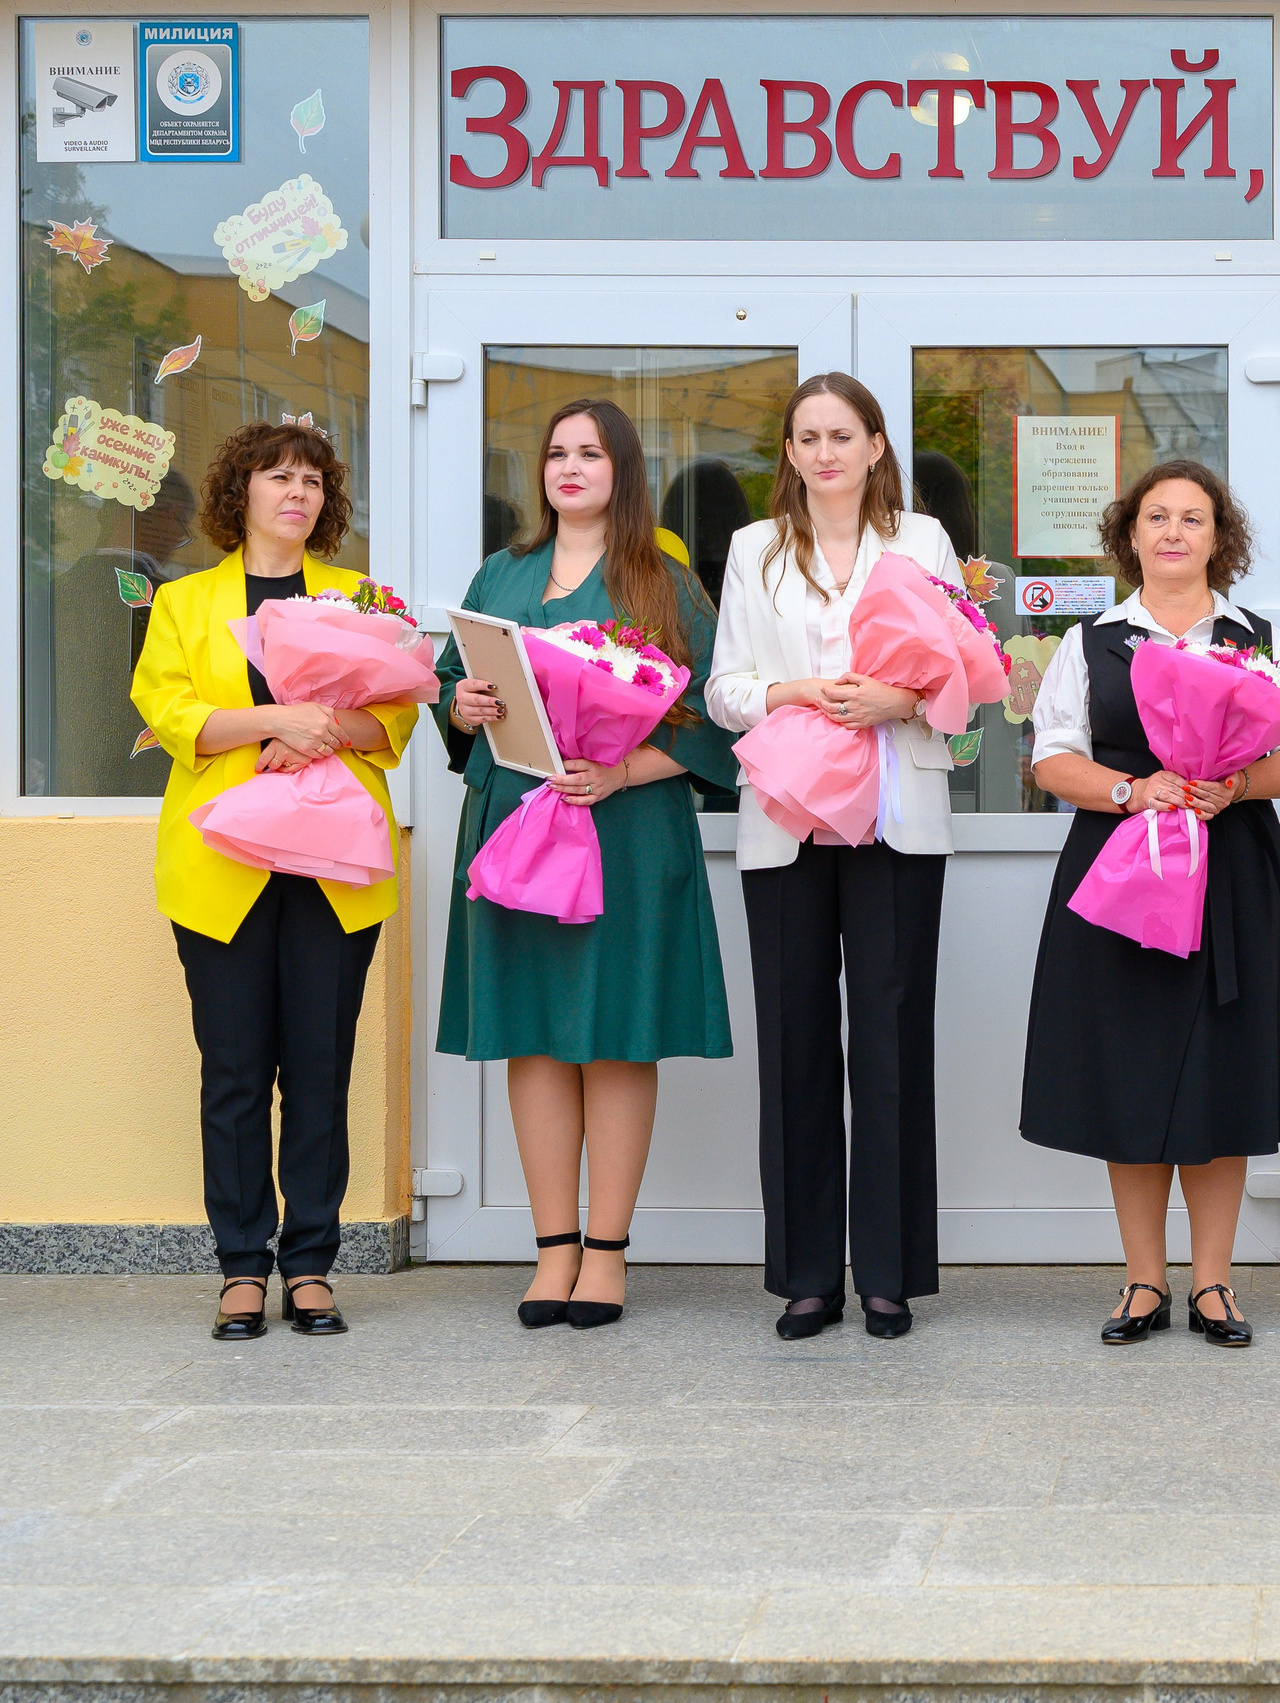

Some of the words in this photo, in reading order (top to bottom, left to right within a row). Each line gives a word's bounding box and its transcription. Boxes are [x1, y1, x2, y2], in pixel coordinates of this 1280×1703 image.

[144, 27, 233, 42] МИЛИЦИЯ
[49, 66, 121, 76] ВНИМАНИЕ
[159, 120, 182, 128] ОБЪЕКТ
[182, 120, 220, 128] ОХРАНЯЕТСЯ
[449, 48, 1264, 204] ЗДРАВСТВУЙ,
[151, 129, 203, 138] ДЕПАРТАМЕНТОМ
[150, 138, 163, 147] МВД
[246, 196, 287, 225] Буду
[98, 416, 130, 436] уже
[132, 429, 166, 451] жду
[1031, 426, 1108, 437] ВНИМАНИЕ!
[96, 434, 157, 464] осенние
[1056, 442, 1078, 452] Вход
[1043, 457, 1097, 466] учреждение
[1041, 469, 1099, 479] образования
[1031, 484, 1075, 494] разрешен
[1042, 496, 1090, 505] учащимся
[1040, 510, 1100, 519] сотрудникам
